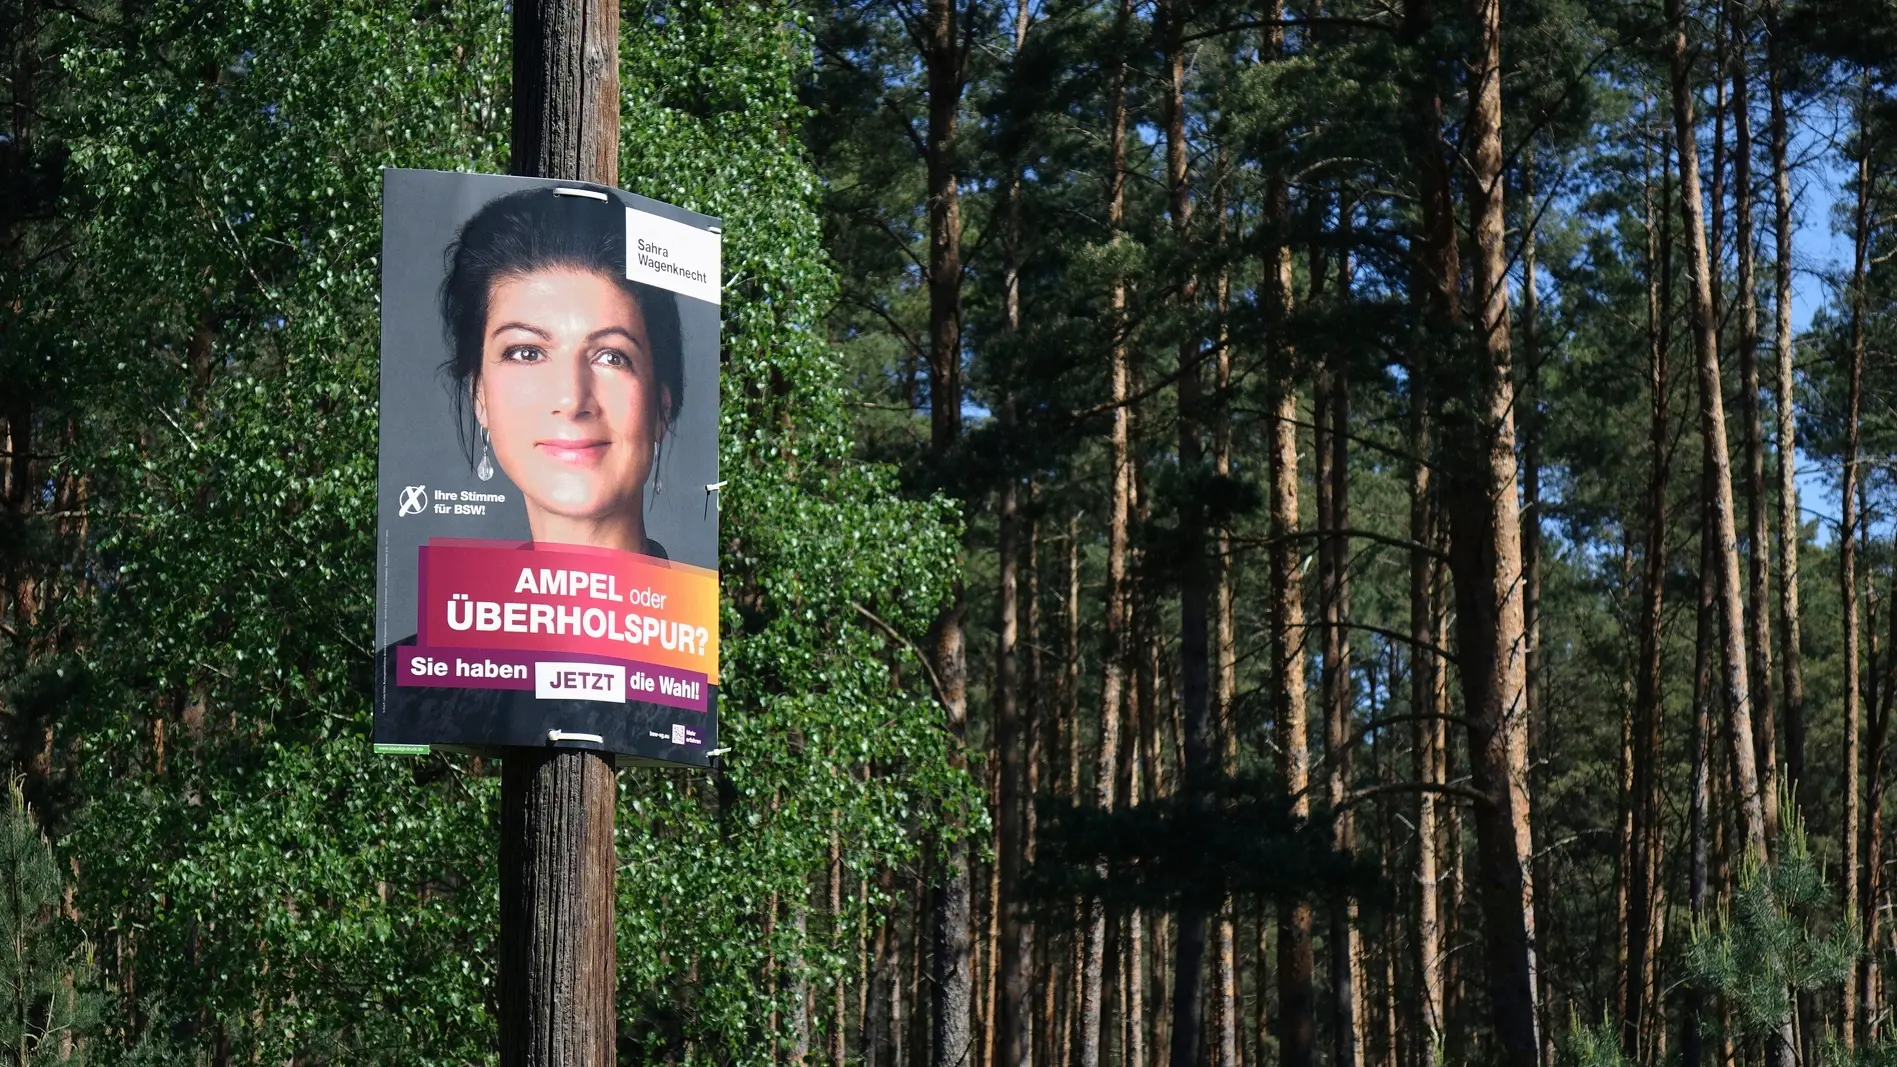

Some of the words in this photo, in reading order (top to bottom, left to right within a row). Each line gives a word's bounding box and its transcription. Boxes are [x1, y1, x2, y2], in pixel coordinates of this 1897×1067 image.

[637, 238, 669, 258] Sahra
[637, 253, 707, 284] Wagenknecht
[433, 503, 452, 514] für
[454, 504, 486, 516] BSW!
[434, 490, 458, 501] Ihre
[460, 491, 506, 503] Stimme
[514, 567, 623, 602] AMPEL
[629, 586, 667, 610] oder
[447, 593, 709, 656] ÜBERHOLSPUR?
[410, 656, 448, 677] Sie
[456, 658, 528, 679] haben
[549, 671, 615, 691] JETZT
[629, 671, 655, 692] die
[659, 675, 700, 700] Wahl!
